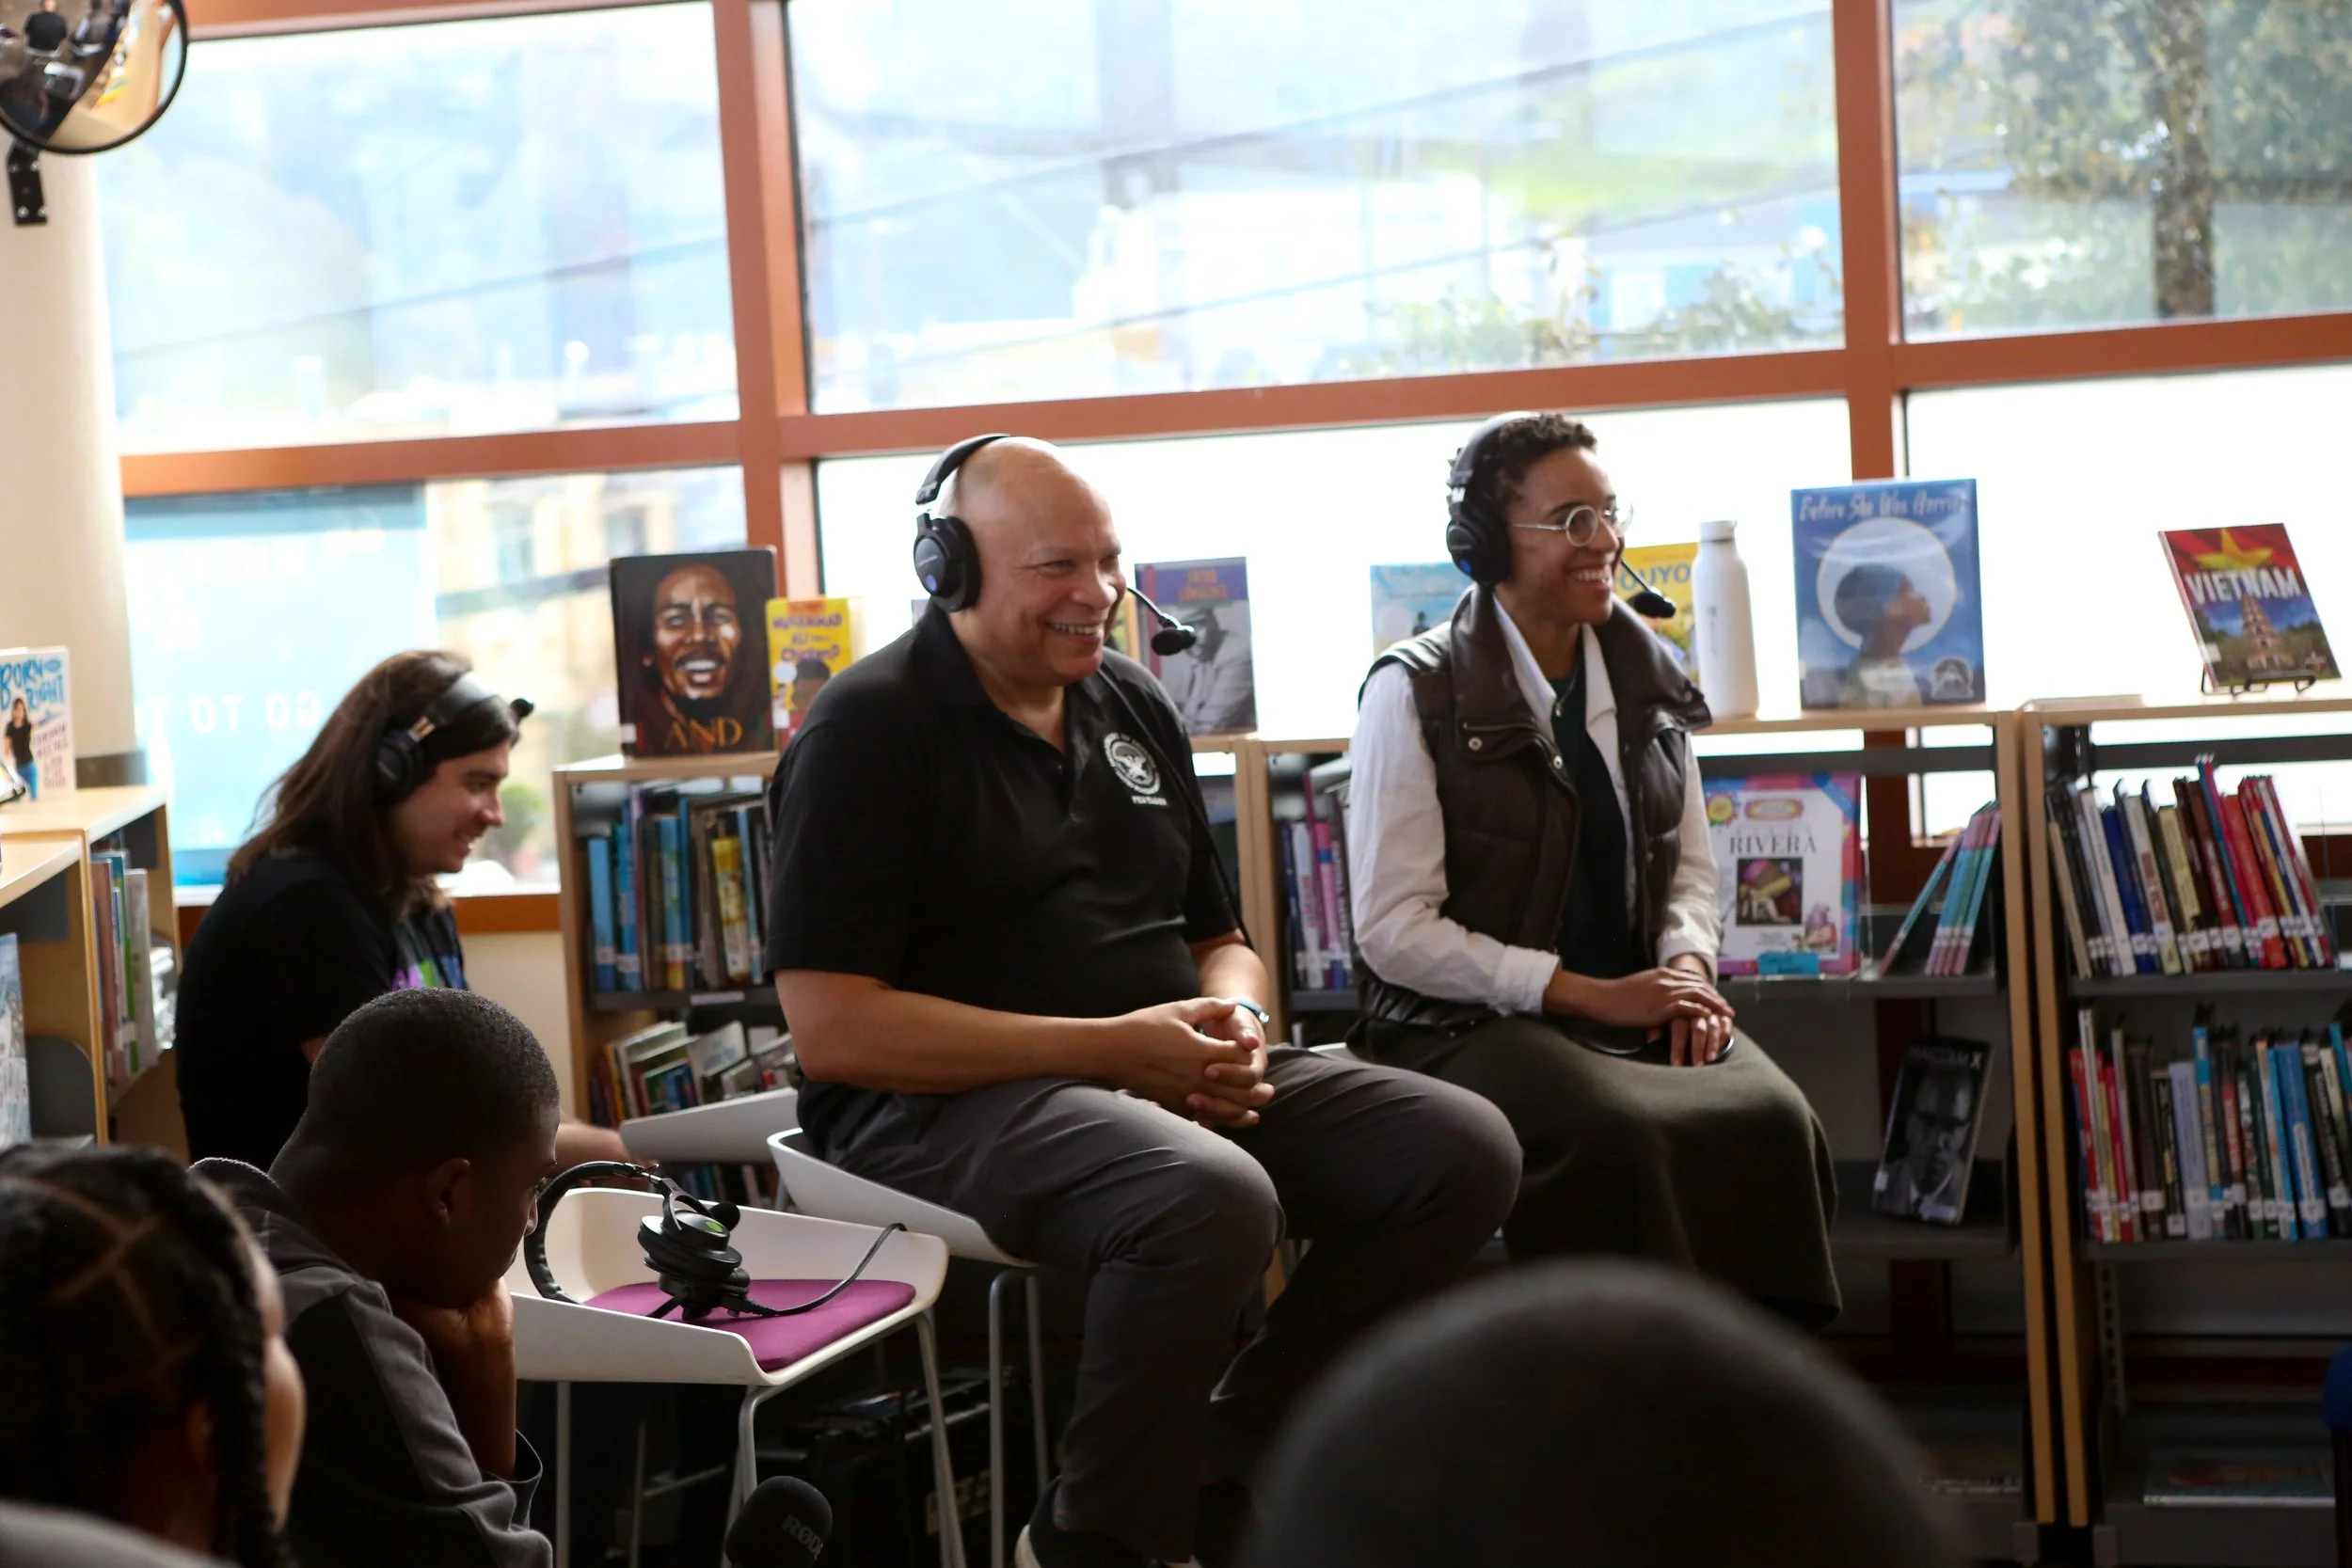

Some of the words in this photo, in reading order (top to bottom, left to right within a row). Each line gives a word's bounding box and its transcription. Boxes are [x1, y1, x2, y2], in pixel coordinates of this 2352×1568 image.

[2184, 566, 2302, 604] VIETNAM
[669, 717, 742, 748] AND
[1729, 833, 1817, 855] RIVERA
